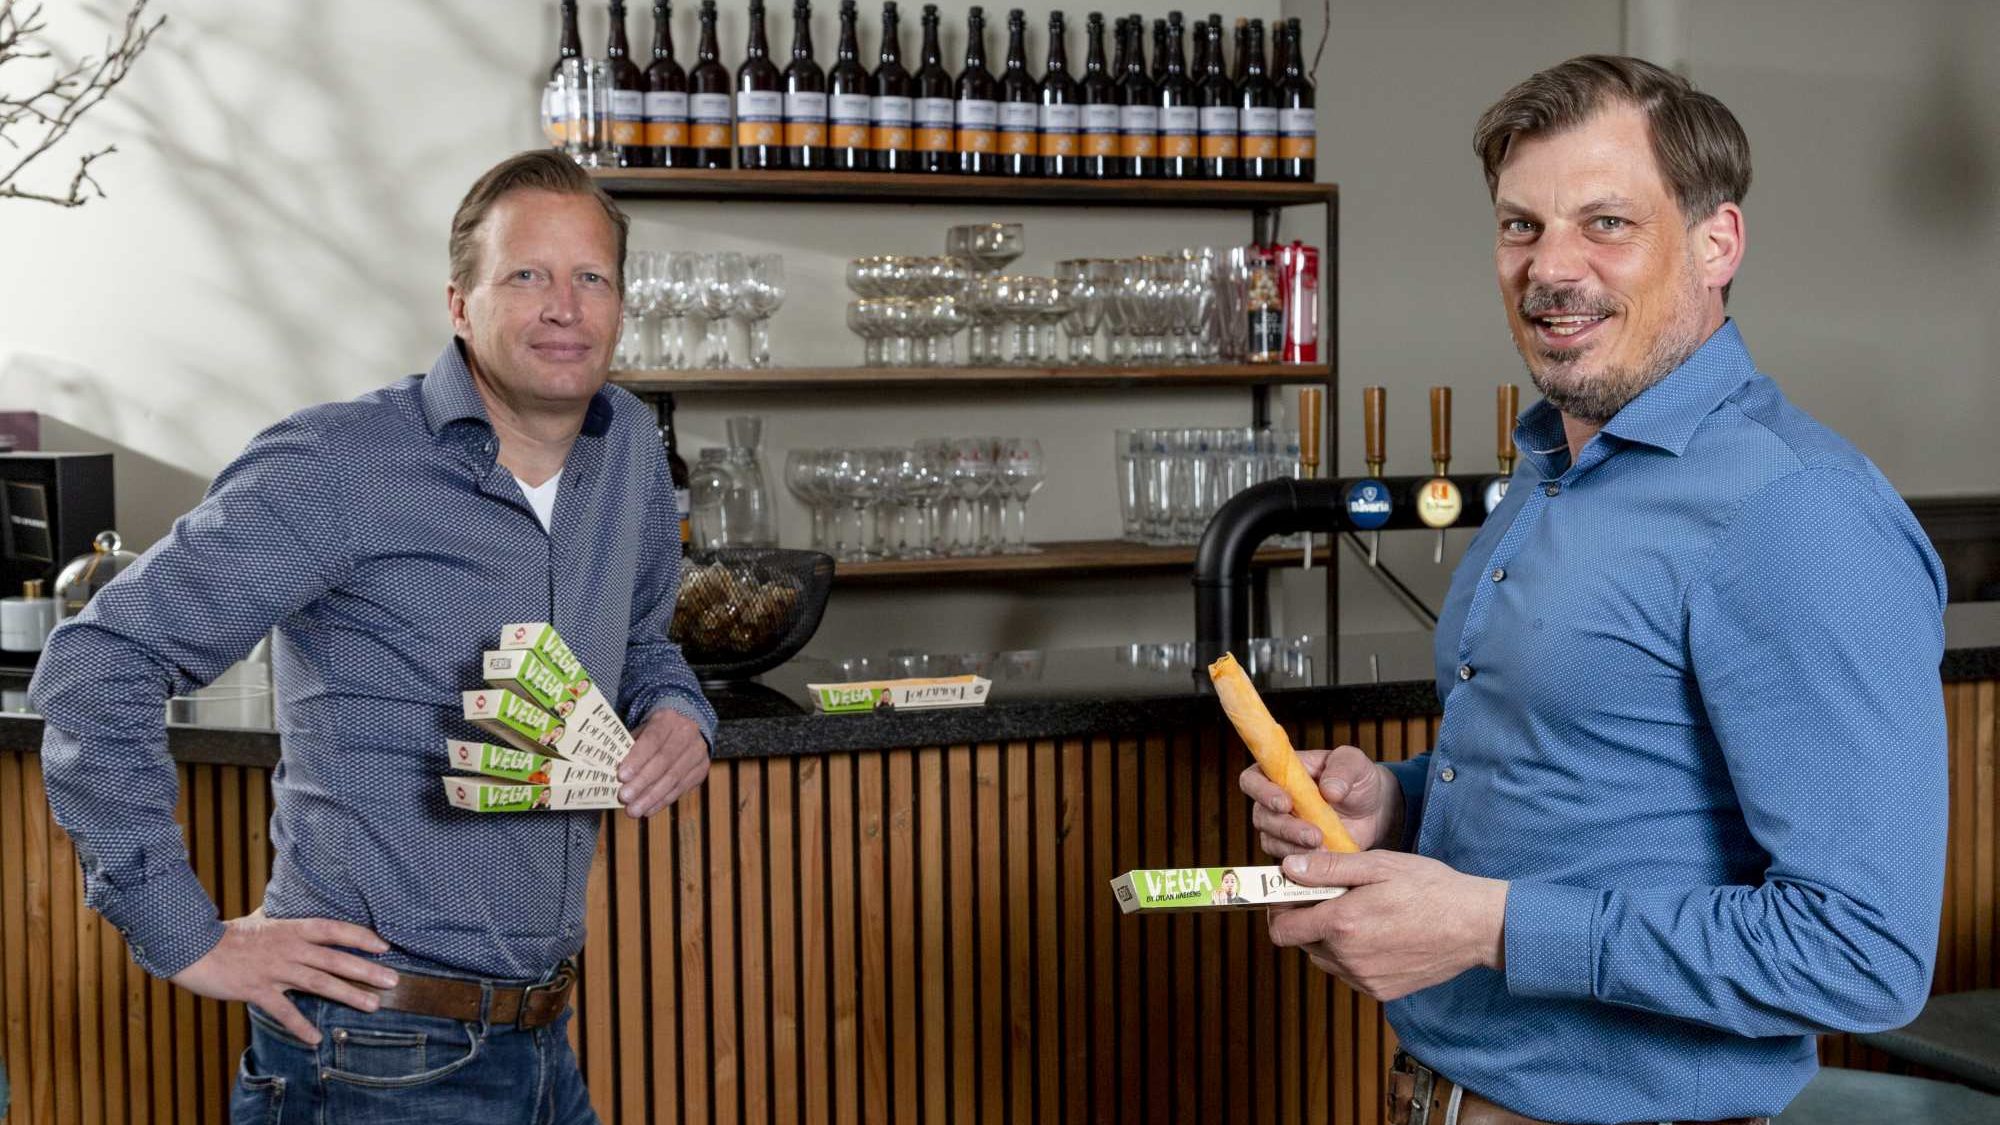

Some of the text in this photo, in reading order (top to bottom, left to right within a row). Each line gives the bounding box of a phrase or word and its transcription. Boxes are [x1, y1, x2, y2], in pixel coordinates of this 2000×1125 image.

[542, 631, 581, 681] VEGA
[525, 657, 564, 705] VEGA
[506, 693, 550, 731] VEGA
[828, 688, 873, 707] VEGA
[490, 746, 533, 771] VEGA
[488, 785, 532, 808] VEGA
[1144, 868, 1213, 898] VEGA
